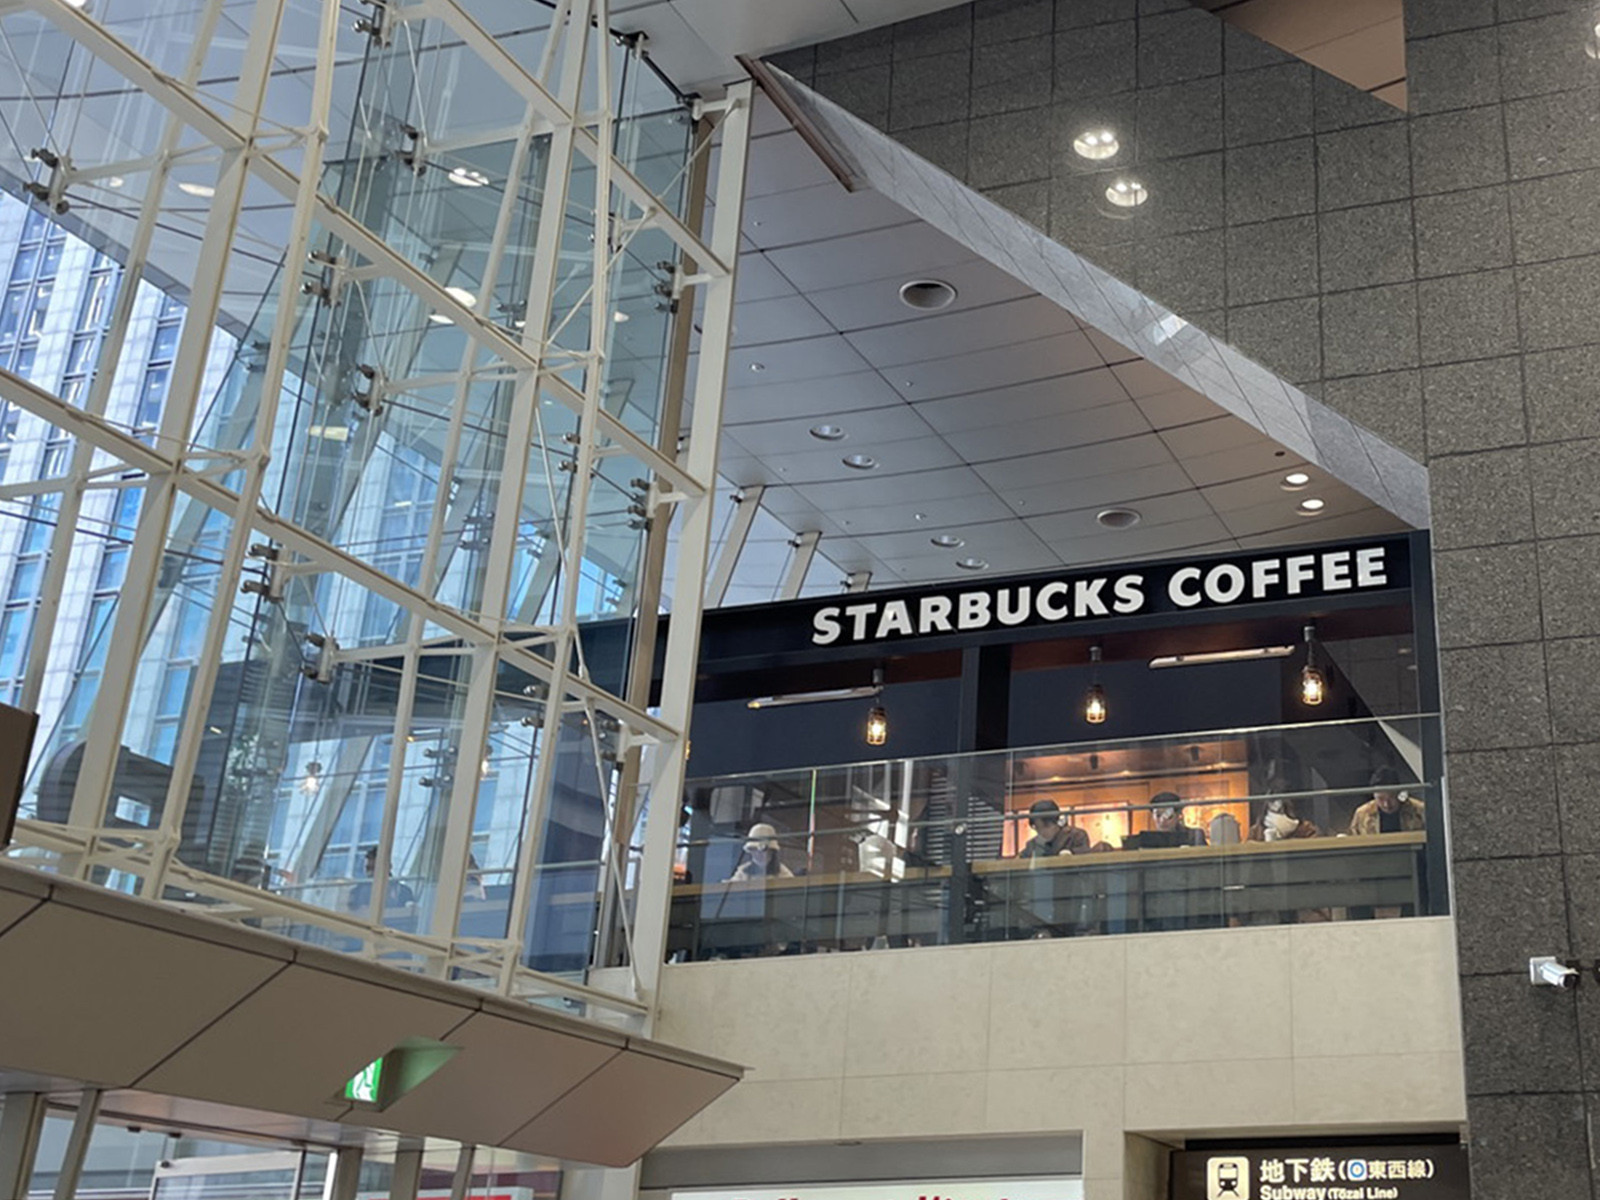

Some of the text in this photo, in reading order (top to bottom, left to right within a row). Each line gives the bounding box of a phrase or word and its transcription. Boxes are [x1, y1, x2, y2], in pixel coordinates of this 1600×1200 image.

[812, 546, 1388, 645] STARBUCKS COFFEE
[1260, 1185, 1326, 1200] Subway
[1366, 1186, 1398, 1200] Line)
